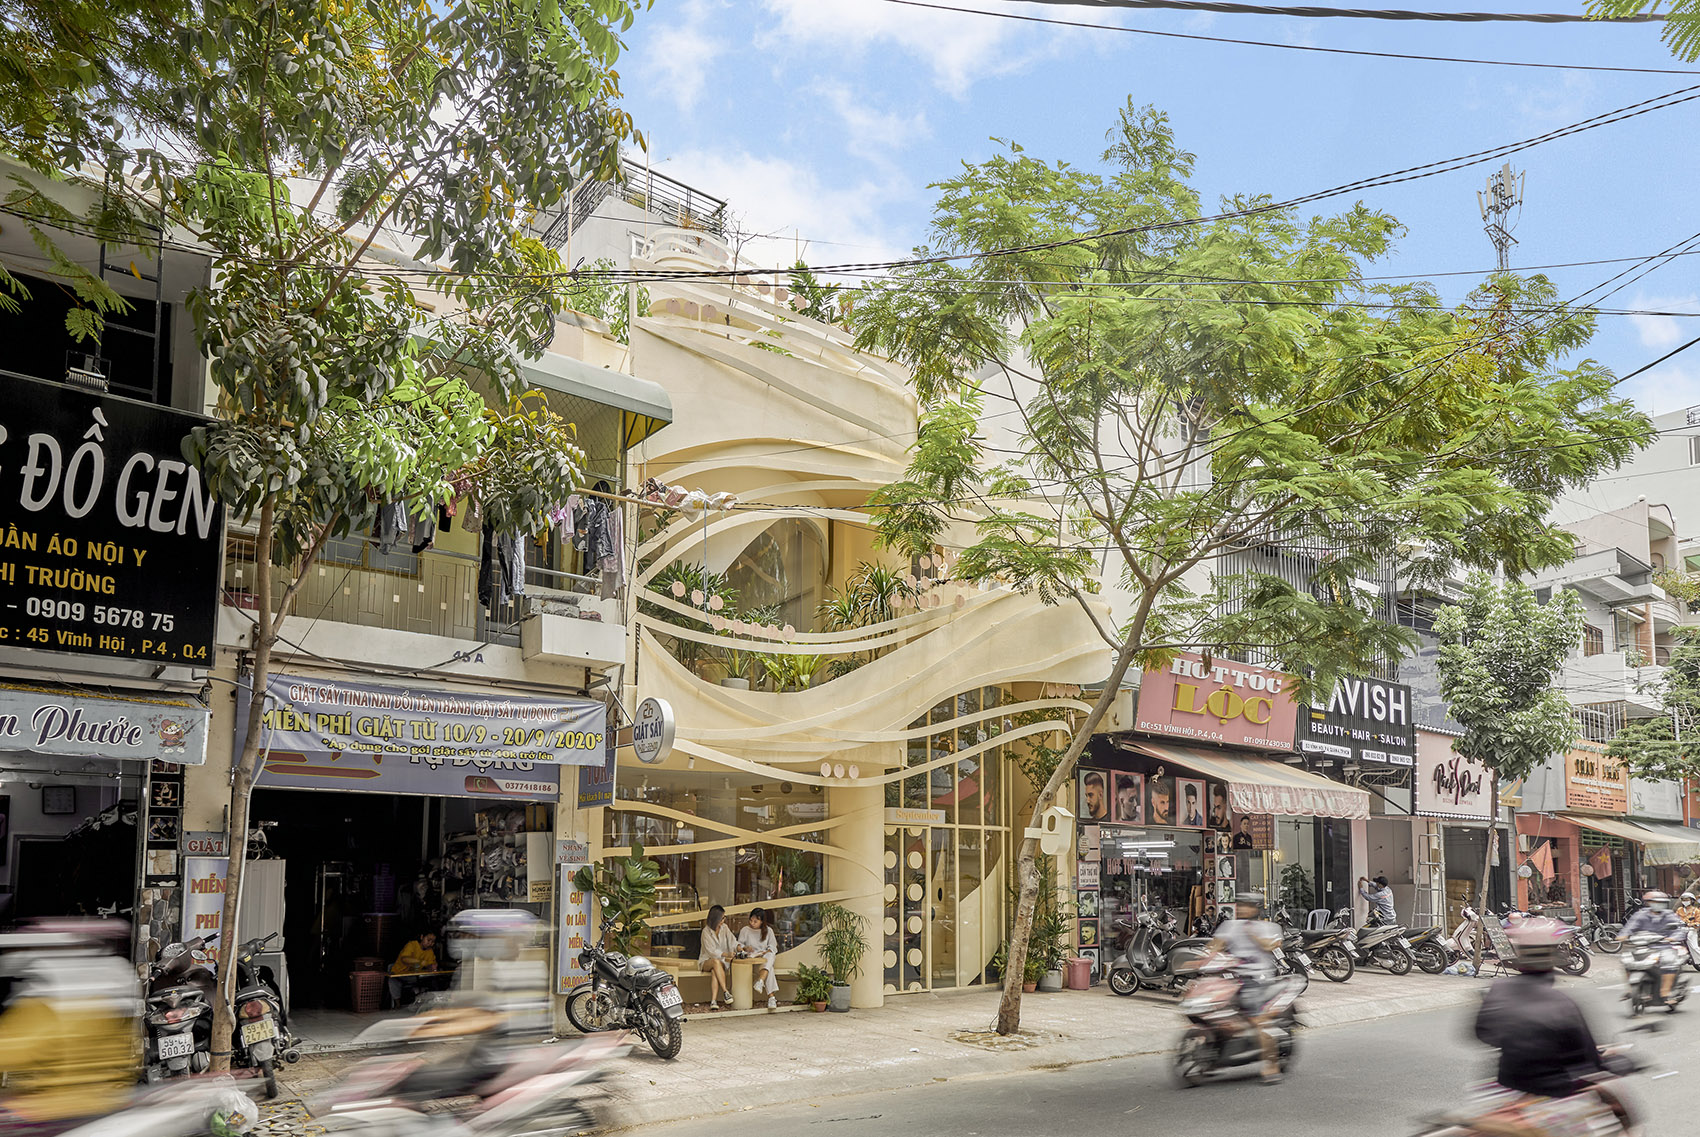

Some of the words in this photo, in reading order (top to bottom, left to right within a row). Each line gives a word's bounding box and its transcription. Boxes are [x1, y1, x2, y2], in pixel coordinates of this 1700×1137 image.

[20, 406, 108, 518] ĐỒ
[115, 452, 215, 539] GEN
[47, 533, 78, 557] ÁO
[87, 541, 124, 566] NỘI
[133, 548, 147, 567] Y
[25, 565, 115, 595] TRƯỜNG
[26, 597, 85, 621] 0909
[93, 605, 144, 629] 5678
[151, 612, 174, 633] 75
[27, 627, 49, 643] 45
[56, 630, 92, 648] Vĩnh
[99, 635, 125, 653] Hội
[142, 639, 167, 655] P.4
[183, 644, 207, 659] Q.4
[1231, 669, 1282, 694] TÓC
[289, 683, 317, 706] GIẶT
[319, 684, 341, 705] SẤY
[343, 690, 368, 707] TINA
[370, 692, 394, 709] NAY
[416, 694, 436, 713] TÊN
[437, 697, 471, 716] THÀNH
[497, 700, 515, 719] SẤY
[517, 705, 530, 723] TỰ
[531, 705, 557, 724] ĐỘNG
[1172, 682, 1274, 725] LỘC
[32, 704, 143, 747] Phước
[262, 703, 311, 732] MIỄN
[316, 711, 352, 735] PHÍ
[356, 714, 406, 742] GIẶT
[409, 717, 438, 740] TỪ
[443, 723, 487, 743] 10/9
[650, 717, 663, 739] SẤY
[1311, 722, 1344, 736] BEAUTY
[1352, 728, 1370, 741] HAIR
[1380, 733, 1406, 747] SALON
[349, 741, 382, 753] dụng
[384, 742, 408, 753] cho
[410, 744, 431, 755] gói
[433, 745, 456, 757] giặt
[457, 746, 477, 757] sấy
[494, 749, 517, 759] 40k
[538, 751, 554, 760] lên
[505, 782, 552, 792] 0377418186
[896, 809, 940, 821] September
[188, 837, 223, 855] GIẶT
[190, 873, 227, 894] MIỄN
[569, 890, 584, 906] GIẶT
[195, 911, 221, 930] PHÍ
[566, 914, 574, 926] 01
[245, 1029, 275, 1045] 247.19
[161, 1043, 192, 1058] 500.32
